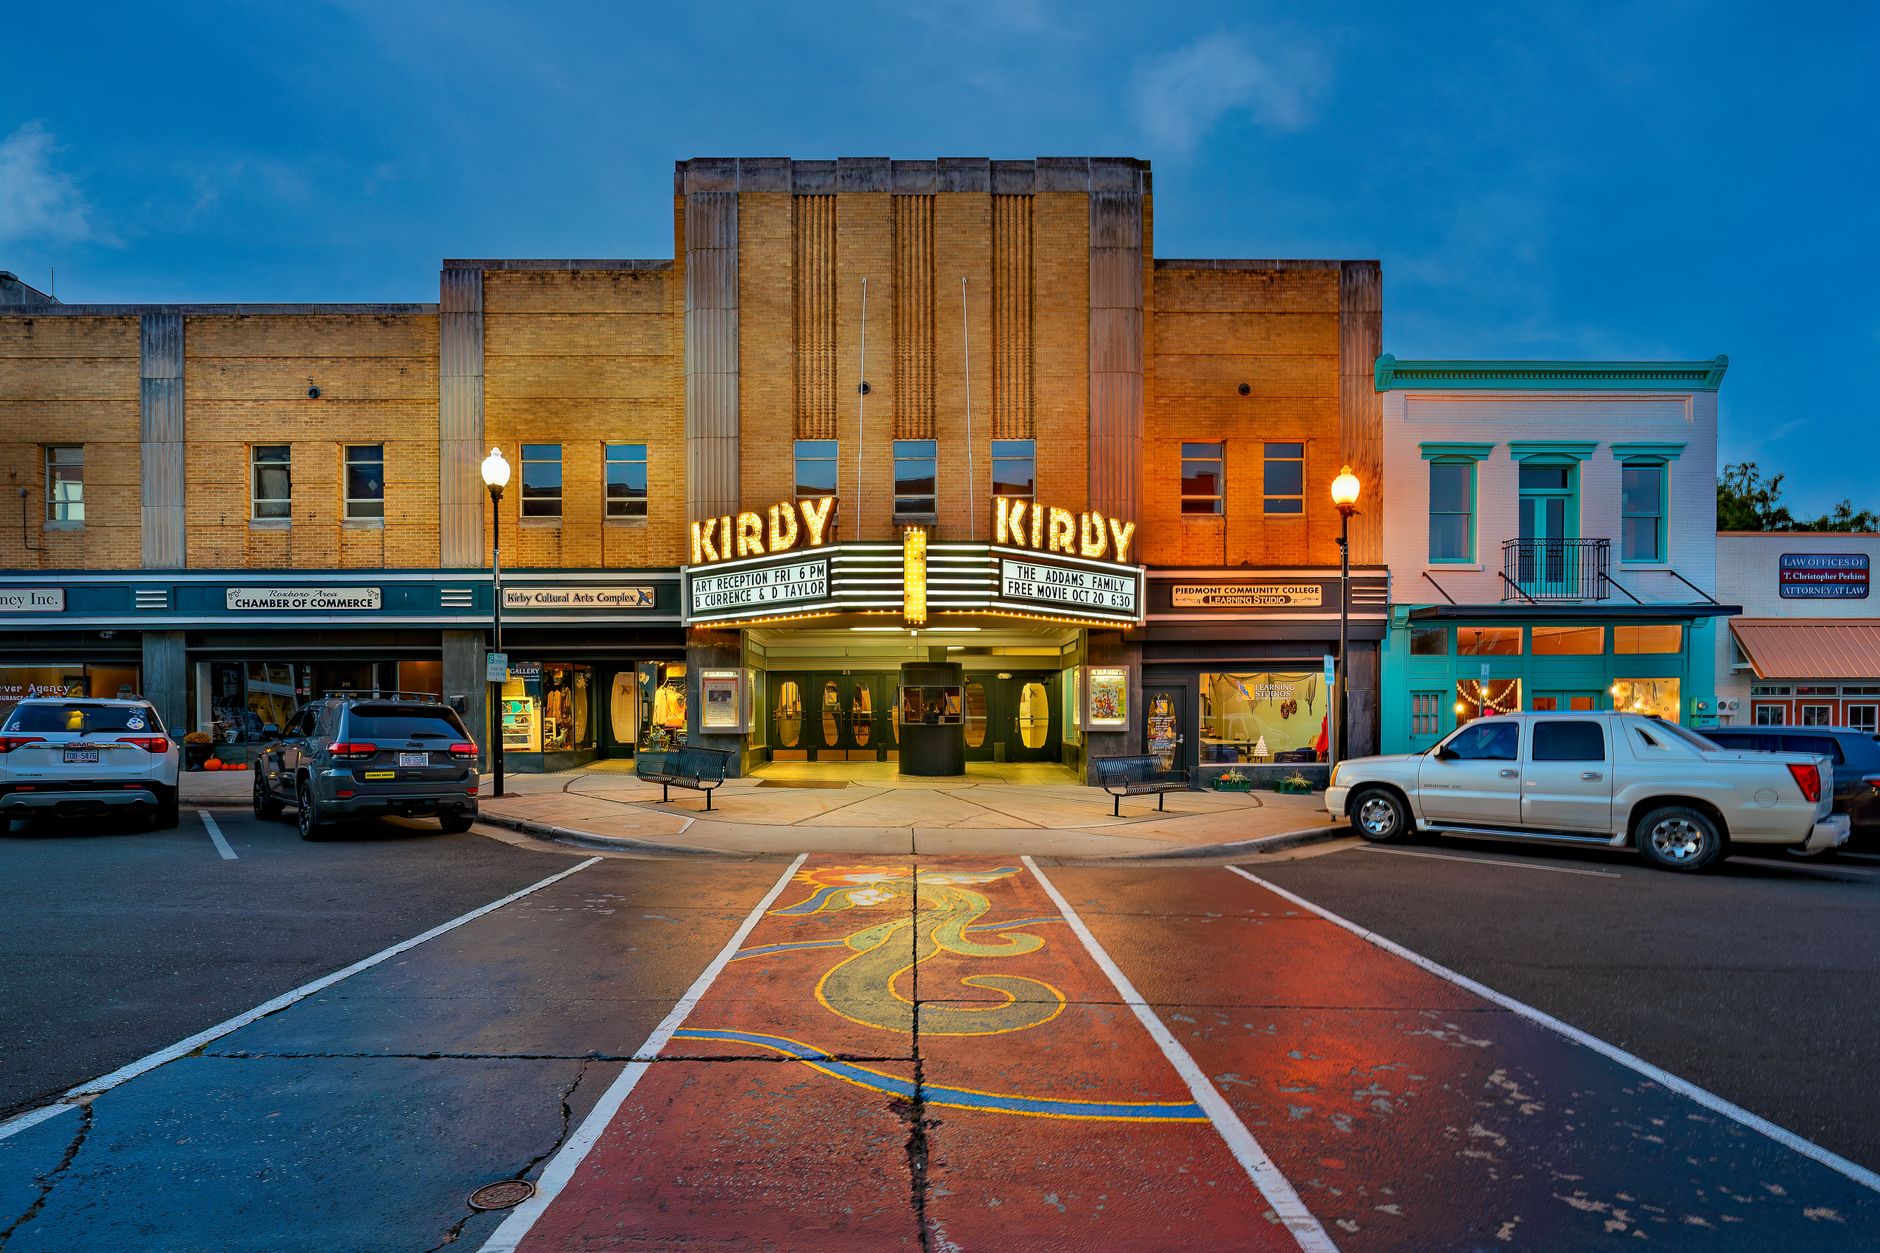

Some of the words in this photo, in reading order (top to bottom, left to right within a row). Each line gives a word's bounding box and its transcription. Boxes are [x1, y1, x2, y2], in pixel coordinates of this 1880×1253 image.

[1784, 558, 1806, 567] LAW
[1807, 558, 1850, 567] OFFICES
[1851, 558, 1866, 567] OF
[695, 579, 713, 593] ART
[717, 572, 768, 590] RECEPTION
[774, 569, 791, 583] FRI
[799, 567, 806, 580] 6
[810, 564, 825, 578] PM
[1017, 566, 1036, 580] THE
[1045, 569, 1084, 587] ADDAMS
[1092, 576, 1125, 592] FAMILY
[1784, 572, 1792, 580] T.
[1792, 571, 1837, 582] Christopher
[1838, 571, 1866, 580] Perkins
[313, 589, 338, 598] Area
[695, 594, 701, 608] B
[705, 589, 752, 607] CURRENCE
[759, 588, 765, 600] &
[772, 586, 778, 599] D
[784, 581, 825, 598] TAYLOR
[1008, 581, 1033, 596] FREE
[1037, 584, 1067, 600] MOVIE
[1072, 589, 1090, 602] OCT
[1093, 591, 1104, 604] 20
[1111, 594, 1130, 607] 6:30
[1175, 587, 1221, 595] PIEDMONT
[1282, 586, 1319, 594] COLLEGE
[1784, 586, 1832, 594] ATTORNEY
[1832, 586, 1845, 594] AT
[1845, 586, 1866, 594] LAW
[30, 592, 58, 605] Inc.
[235, 598, 290, 608] CHAMBER
[292, 598, 308, 608] OF
[310, 598, 373, 608] COMMERCE
[507, 592, 533, 605] Kirby
[534, 592, 570, 603] Cultural
[572, 592, 594, 603] Arts
[596, 592, 636, 606] Complex
[1209, 595, 1252, 605] LEARNING
[1252, 595, 1286, 604] STUDIO
[28, 683, 70, 695] Agency
